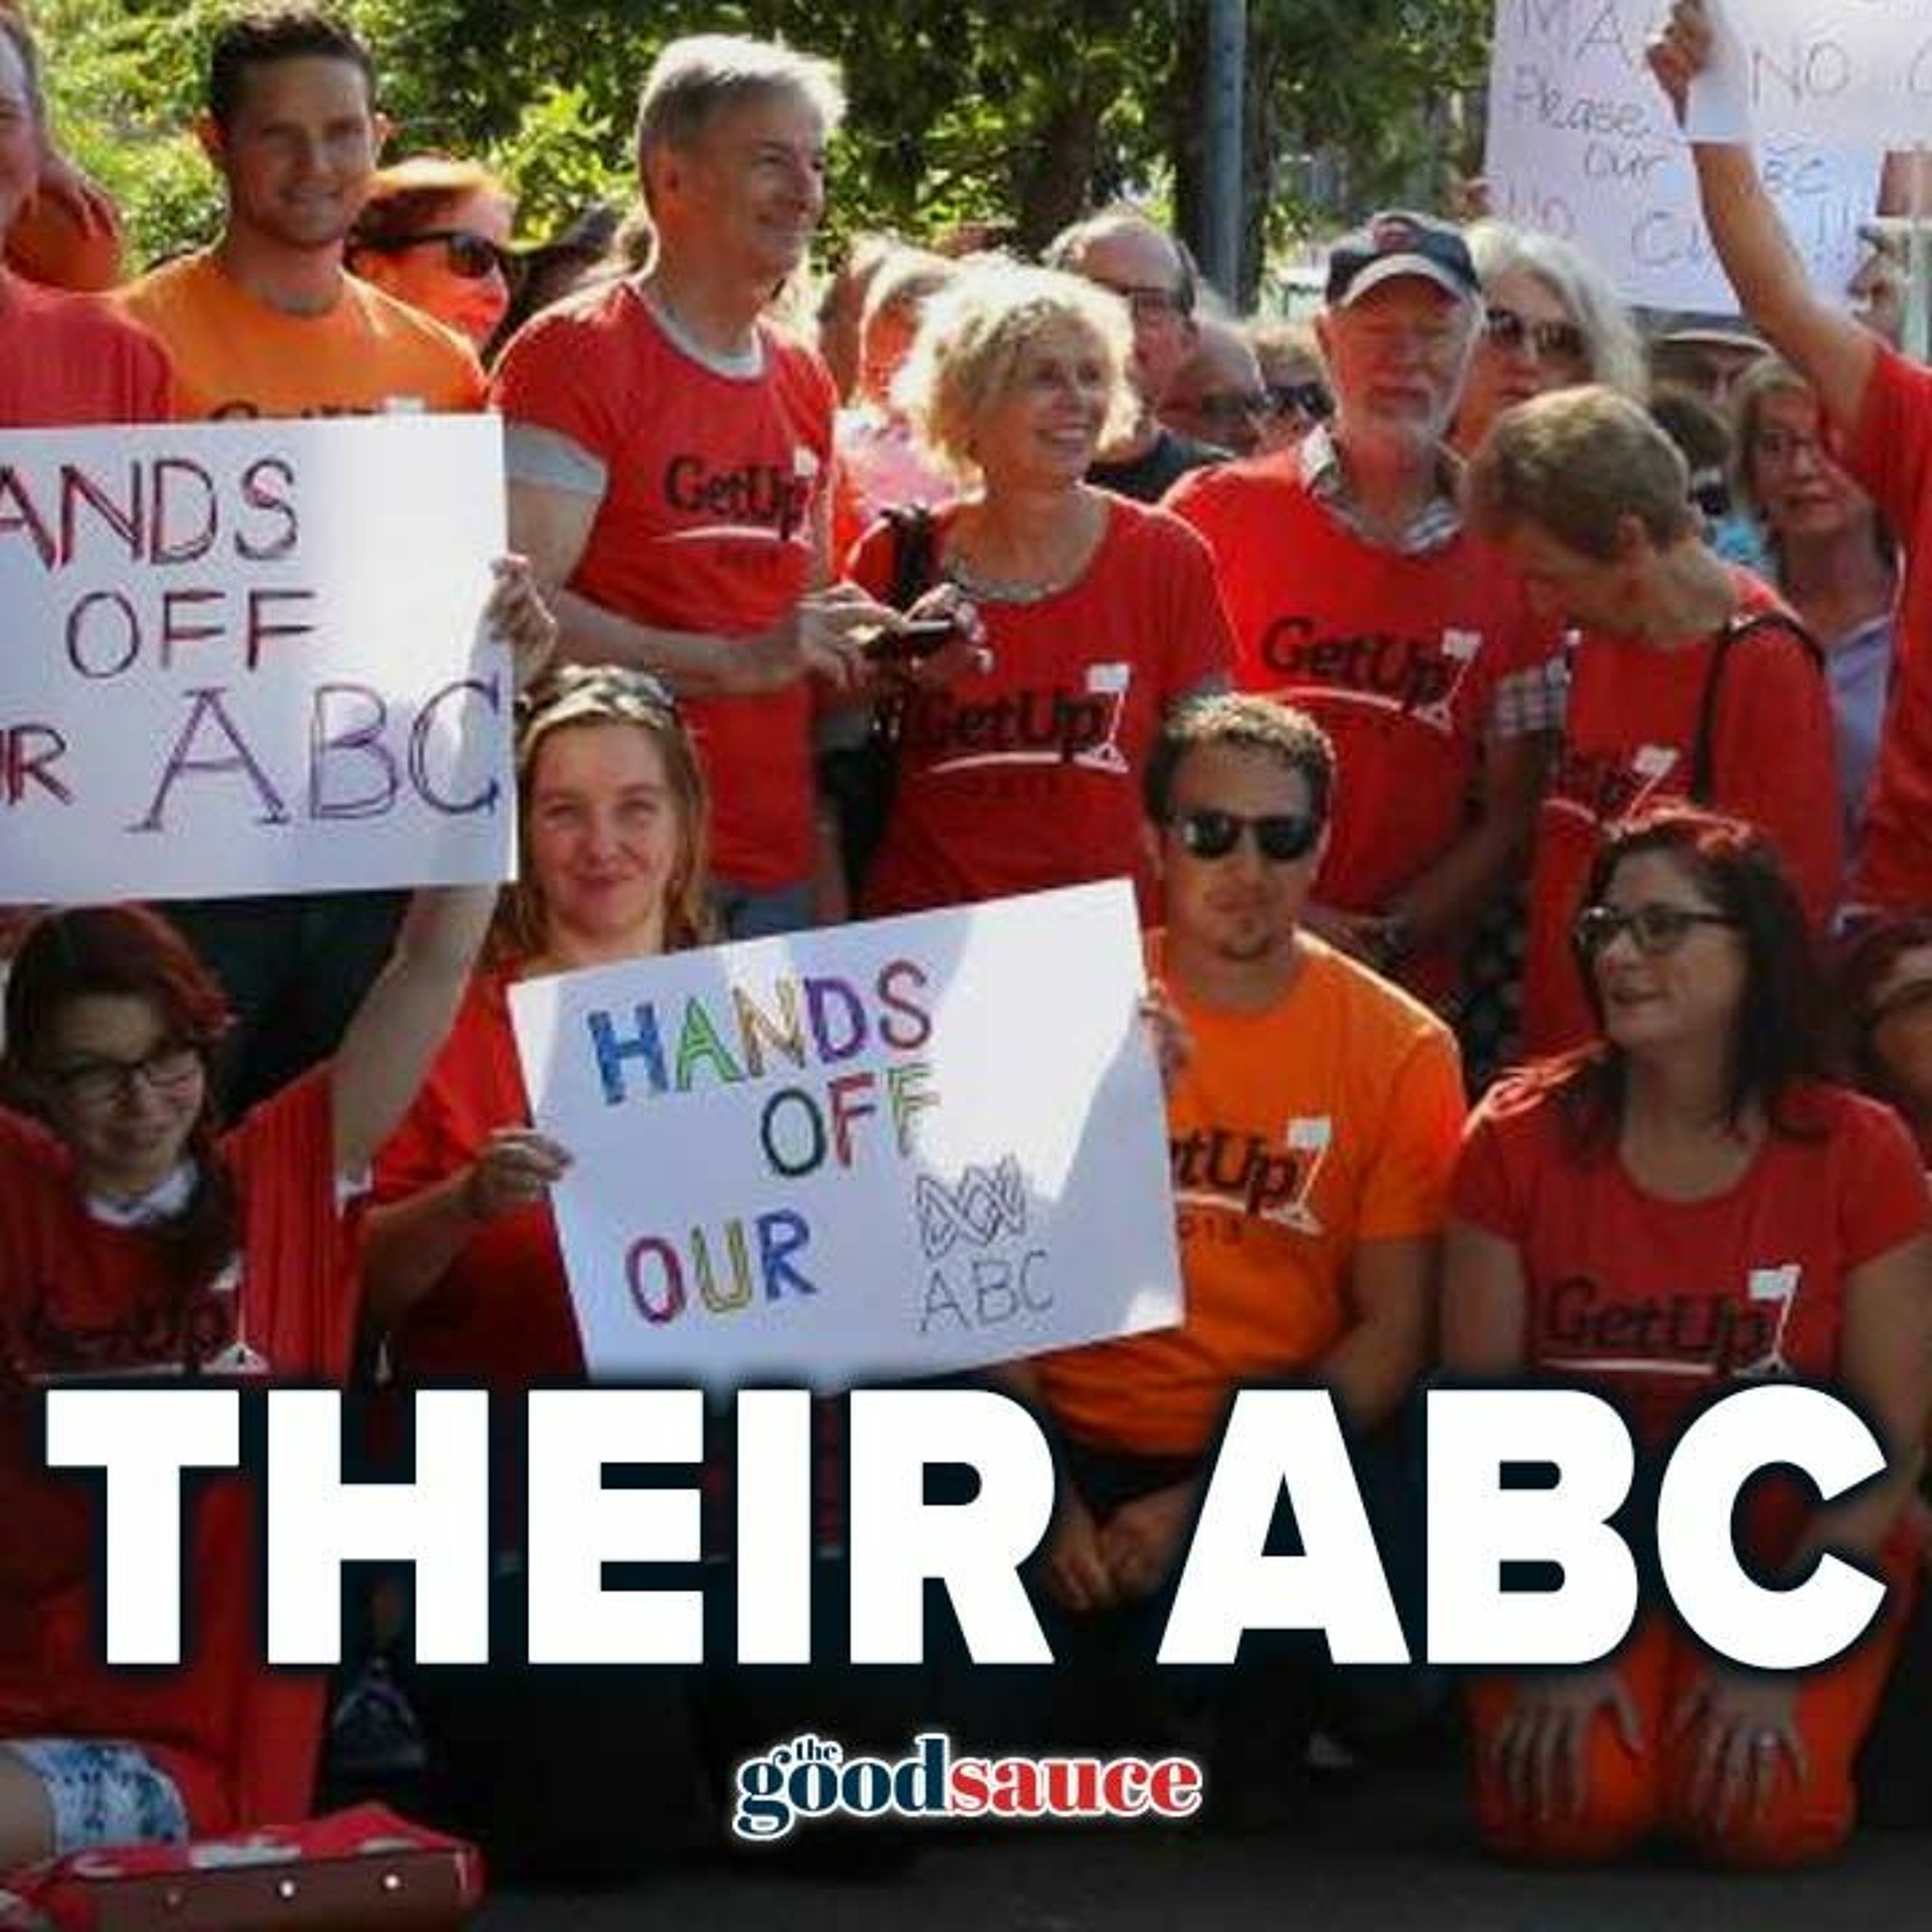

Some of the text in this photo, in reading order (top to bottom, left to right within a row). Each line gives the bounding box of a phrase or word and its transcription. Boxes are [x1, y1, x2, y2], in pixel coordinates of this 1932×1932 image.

[66, 589, 316, 679] OFF
[0, 674, 500, 833] R ABC
[587, 959, 933, 1105] HANDS
[760, 1062, 940, 1178] OFF
[625, 1208, 1054, 1333] OUR ABC
